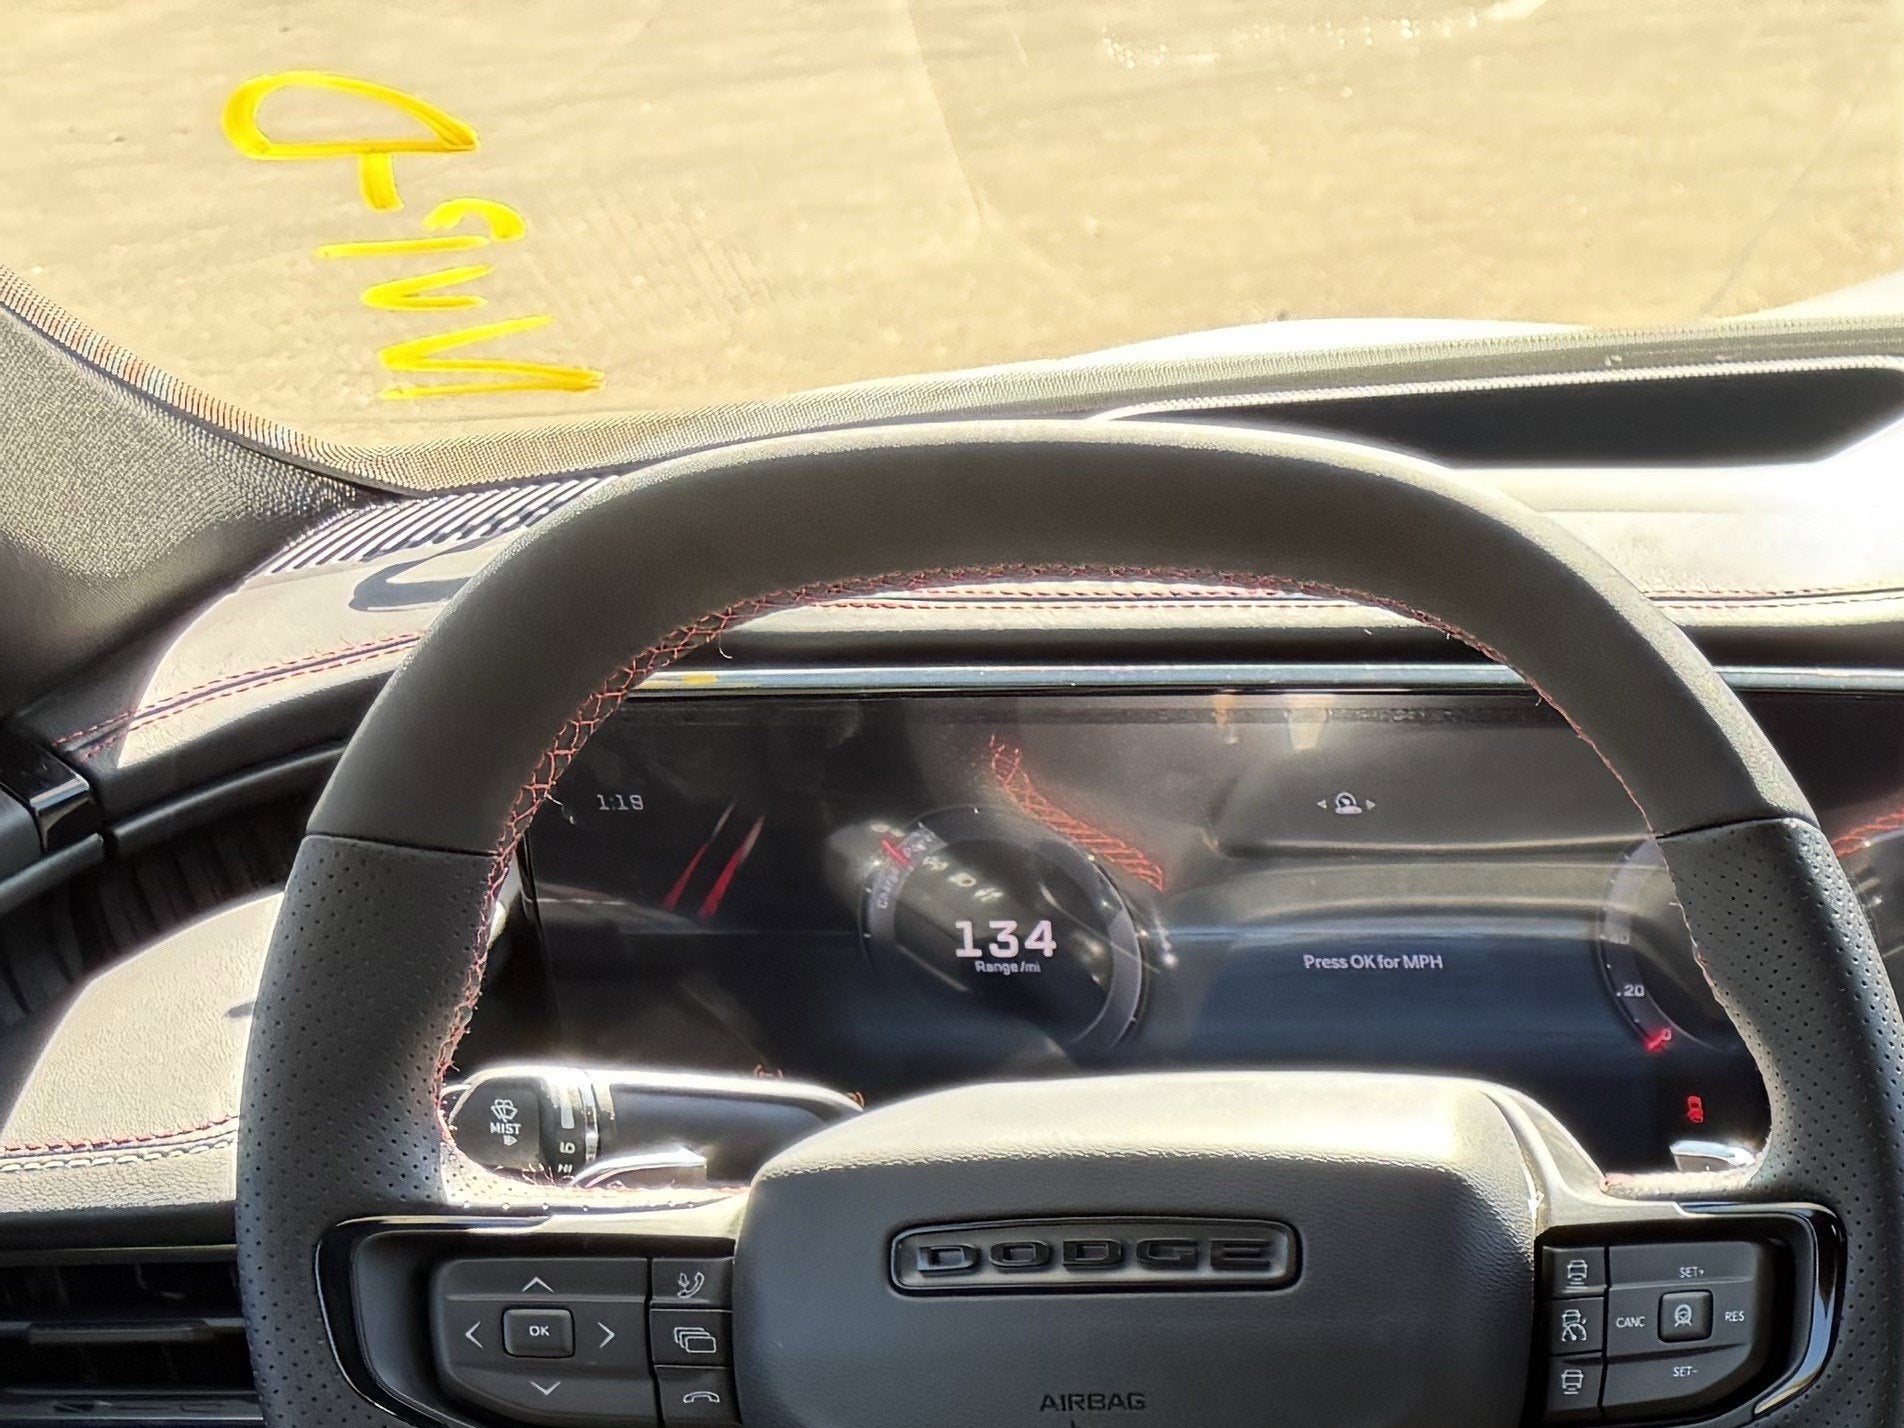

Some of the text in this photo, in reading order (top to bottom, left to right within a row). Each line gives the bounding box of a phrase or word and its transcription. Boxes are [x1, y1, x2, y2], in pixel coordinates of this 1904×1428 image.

[955, 919, 1057, 958] 134
[1302, 953, 1444, 970] Press OK for MPH
[490, 1122, 521, 1135] MIST
[916, 1238, 1290, 1271] DODGE
[1616, 1316, 1646, 1329] CANC
[1724, 1310, 1745, 1323] RES
[529, 1325, 551, 1337] OK
[1039, 1392, 1147, 1413] AIRBAG
